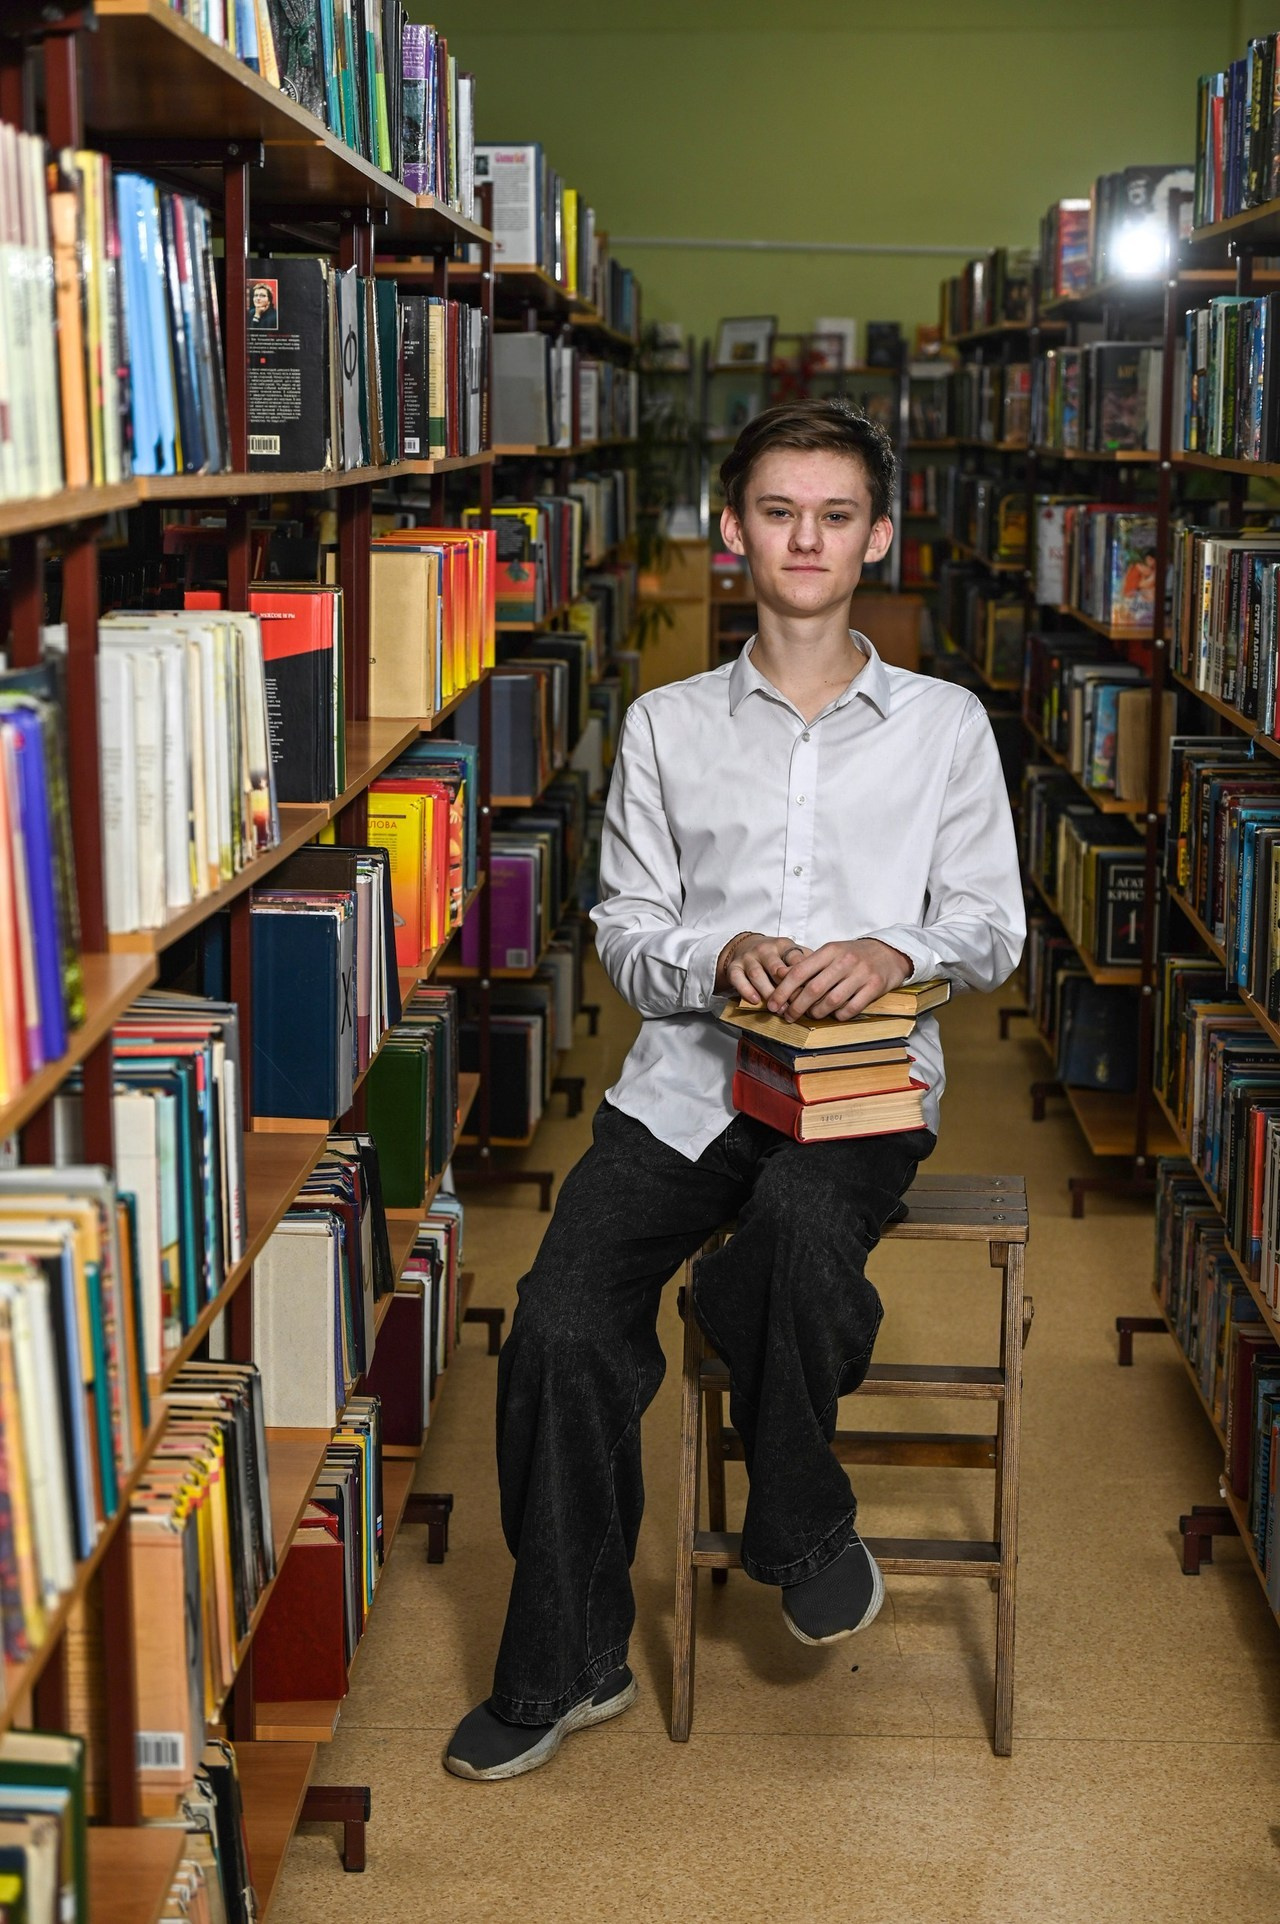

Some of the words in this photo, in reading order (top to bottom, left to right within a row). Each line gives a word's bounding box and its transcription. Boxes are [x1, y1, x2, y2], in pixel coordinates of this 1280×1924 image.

[1253, 603, 1261, 634] СТИГ
[1252, 636, 1260, 690] ЛАРССОН
[1116, 877, 1144, 888] АГАТ
